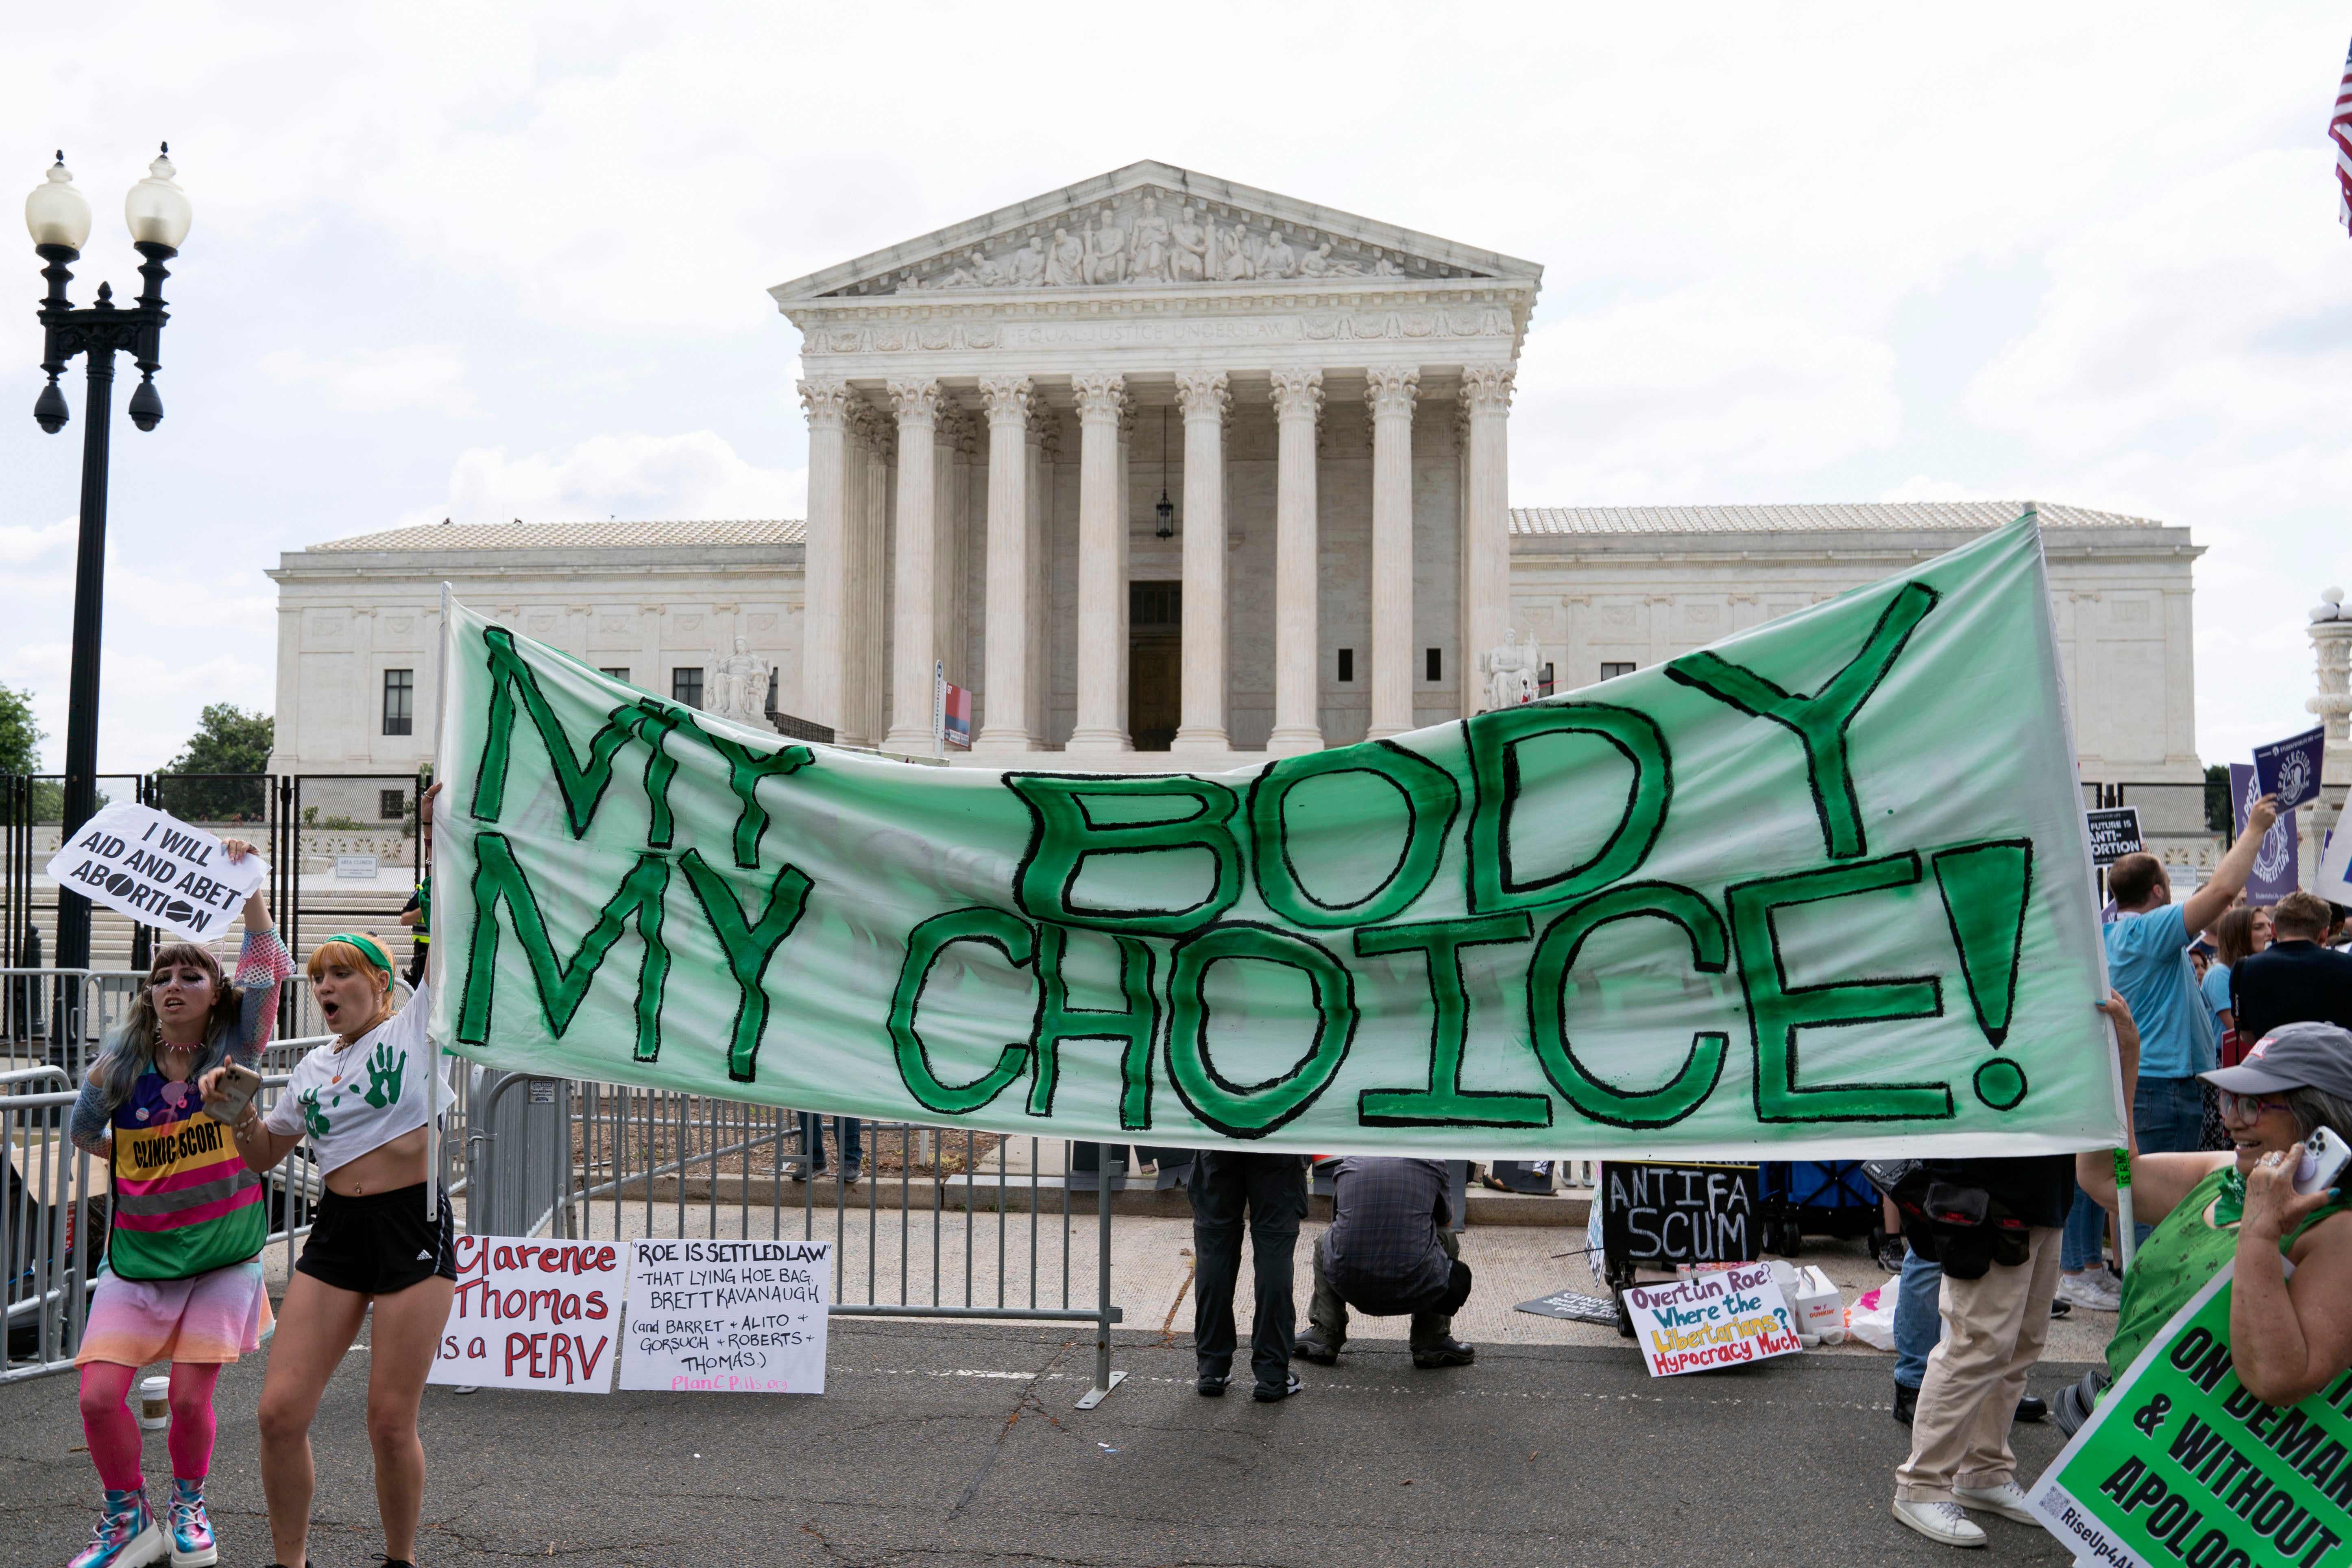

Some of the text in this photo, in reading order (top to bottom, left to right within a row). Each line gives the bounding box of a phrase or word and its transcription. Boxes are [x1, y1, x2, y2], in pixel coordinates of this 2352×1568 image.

[1018, 322, 1284, 344] EQUAL JUSTICE UNDER LAW
[947, 685, 953, 695] 97
[470, 579, 1943, 940] MY BODY
[142, 822, 213, 867] I WILL
[2090, 820, 2132, 831] FUTURE IS
[2090, 830, 2122, 843] ANTI-
[78, 831, 242, 911] AID AND ABET
[70, 860, 212, 933] ABORTION
[456, 831, 2034, 1139] MY CHOICE!
[133, 1135, 177, 1169] CLINIC
[1611, 1166, 1750, 1220] ANTIFA
[453, 1236, 616, 1276] Clarence
[686, 1243, 708, 1261] IS
[1628, 1207, 1747, 1261] SCUM
[651, 1284, 823, 1311] BRETT KAVANAUGH.
[690, 1269, 735, 1286] LYING
[742, 1268, 775, 1283] HOE
[1631, 1263, 1773, 1309] Overtun Roe?
[454, 1278, 608, 1325] Thomas
[1651, 1292, 1762, 1329] Where the
[632, 1320, 658, 1334] (and
[666, 1319, 724, 1335] BARRET
[741, 1314, 789, 1331] ALITO
[640, 1336, 709, 1355] GORSUCH
[728, 1332, 802, 1349] ROBERTS
[467, 1337, 486, 1359] a
[505, 1332, 608, 1385] PERV
[681, 1351, 766, 1374] THOMAS.)
[1653, 1328, 1801, 1375] Hypocracy Much
[2170, 1327, 2233, 1396] ON
[2221, 1384, 2352, 1519] DEMAN
[2133, 1393, 2343, 1568] & WITHOUT
